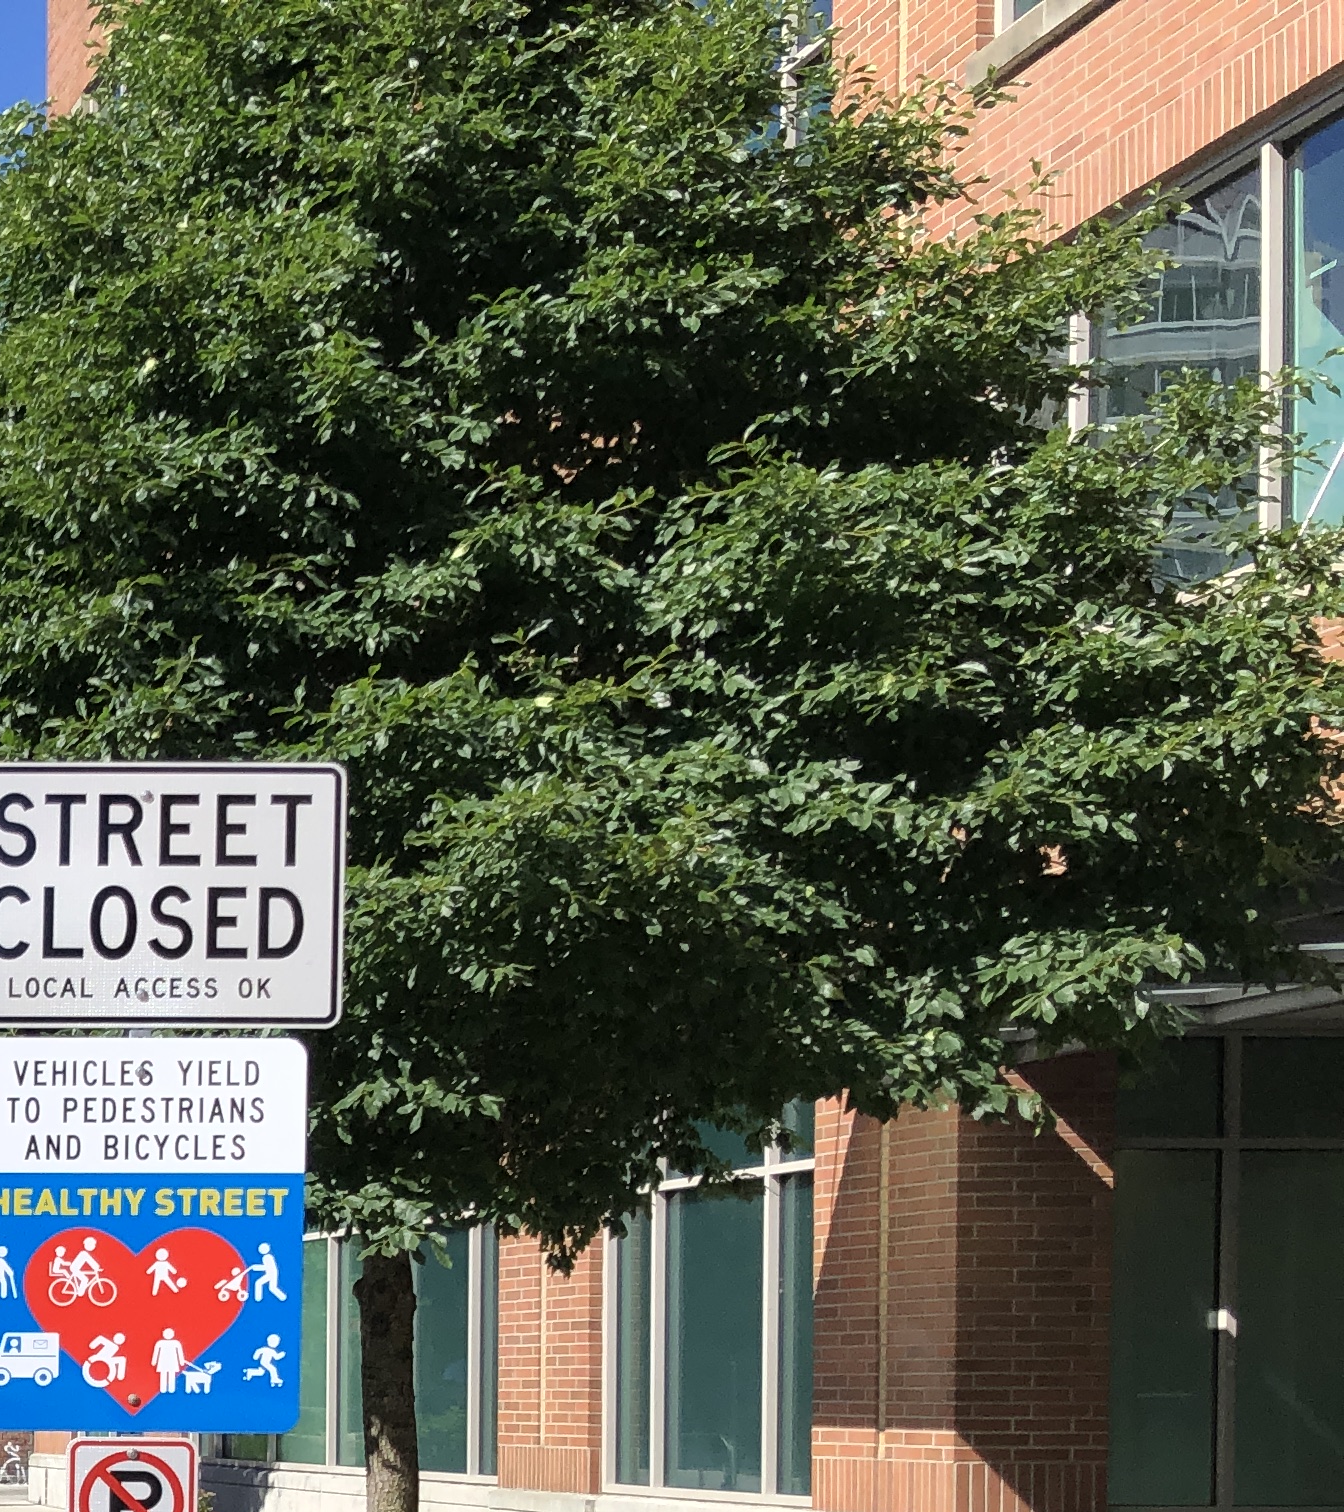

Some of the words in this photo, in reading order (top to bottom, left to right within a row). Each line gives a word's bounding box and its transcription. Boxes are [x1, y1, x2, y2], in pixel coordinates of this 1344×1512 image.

[8, 977, 94, 999] LOCAL
[113, 977, 218, 1000] ACCESS
[238, 977, 272, 999] OK
[13, 1060, 154, 1087] VEHICLES
[178, 1060, 261, 1087] YIELD
[7, 1097, 41, 1124] TO
[63, 1097, 265, 1124] PEDESTRIANS
[24, 1134, 82, 1160] AND
[103, 1134, 246, 1161] BICYCLES
[155, 1188, 288, 1216] STREET
